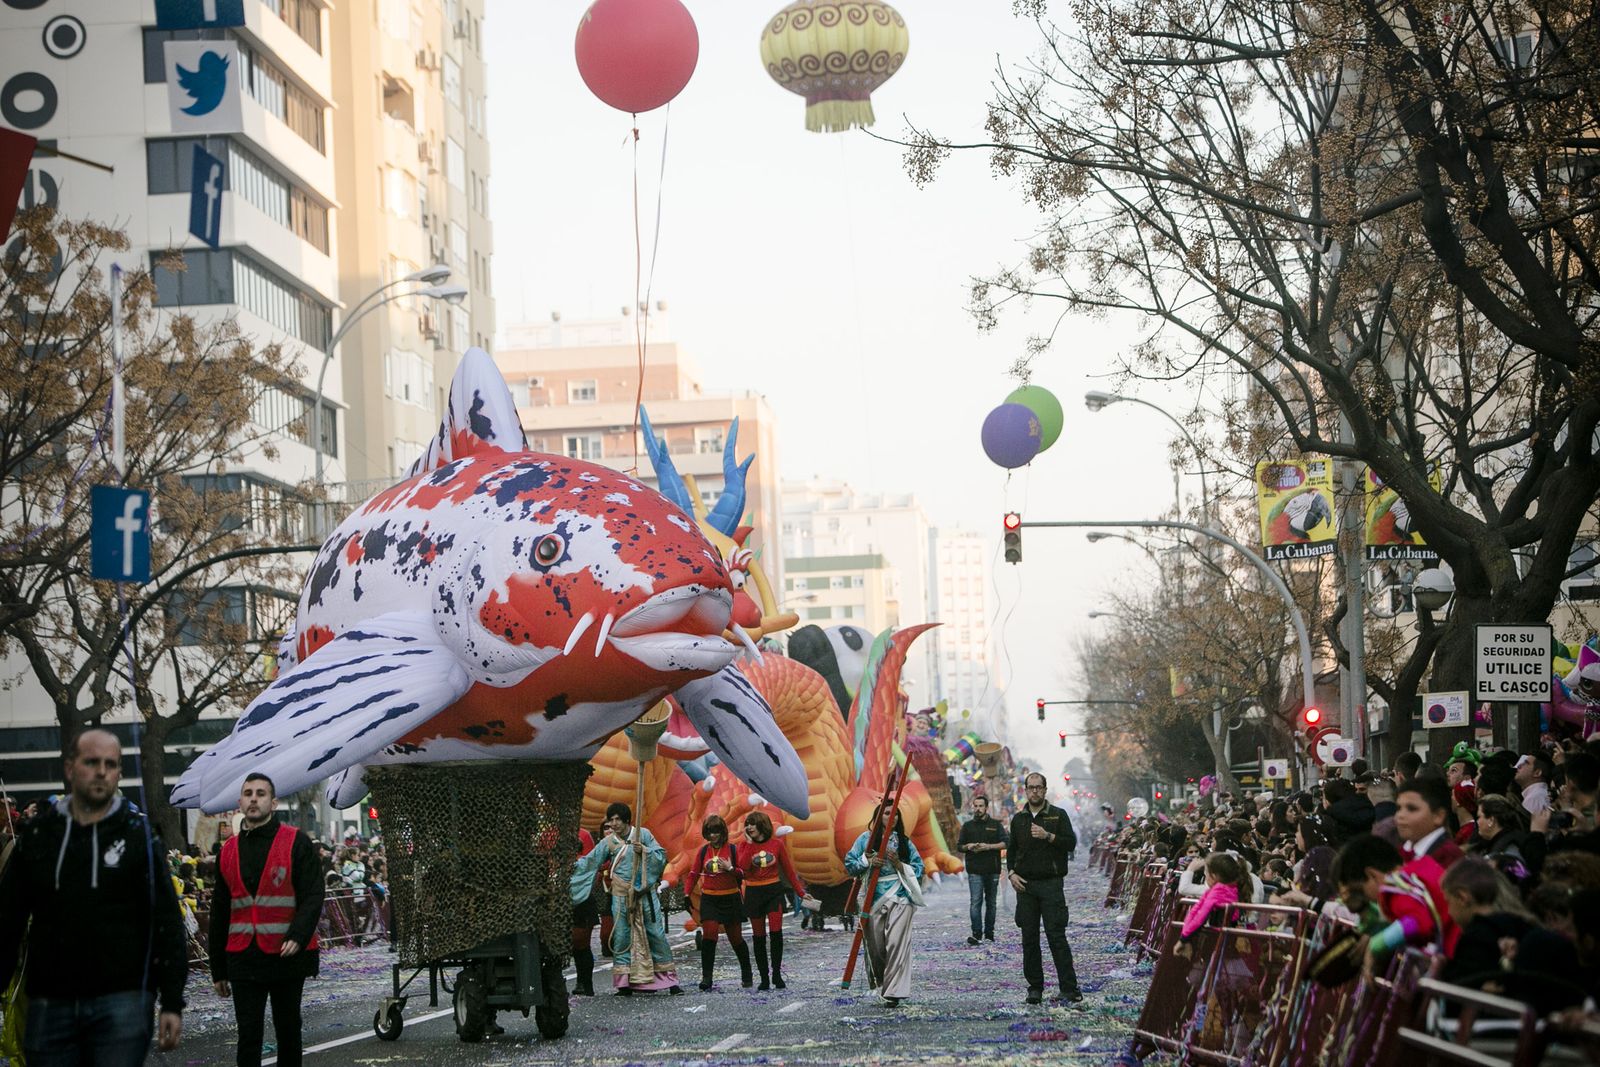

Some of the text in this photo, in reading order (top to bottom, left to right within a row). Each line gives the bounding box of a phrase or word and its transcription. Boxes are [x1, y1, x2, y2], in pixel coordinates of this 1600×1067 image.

[1267, 543, 1334, 560] La Cubana
[1370, 546, 1438, 559] La Cubana
[1494, 633, 1535, 643] POR SU
[1483, 646, 1545, 656] SEGURIDAD
[1486, 662, 1542, 675] UTILICE
[1479, 680, 1549, 693] EL CASCO
